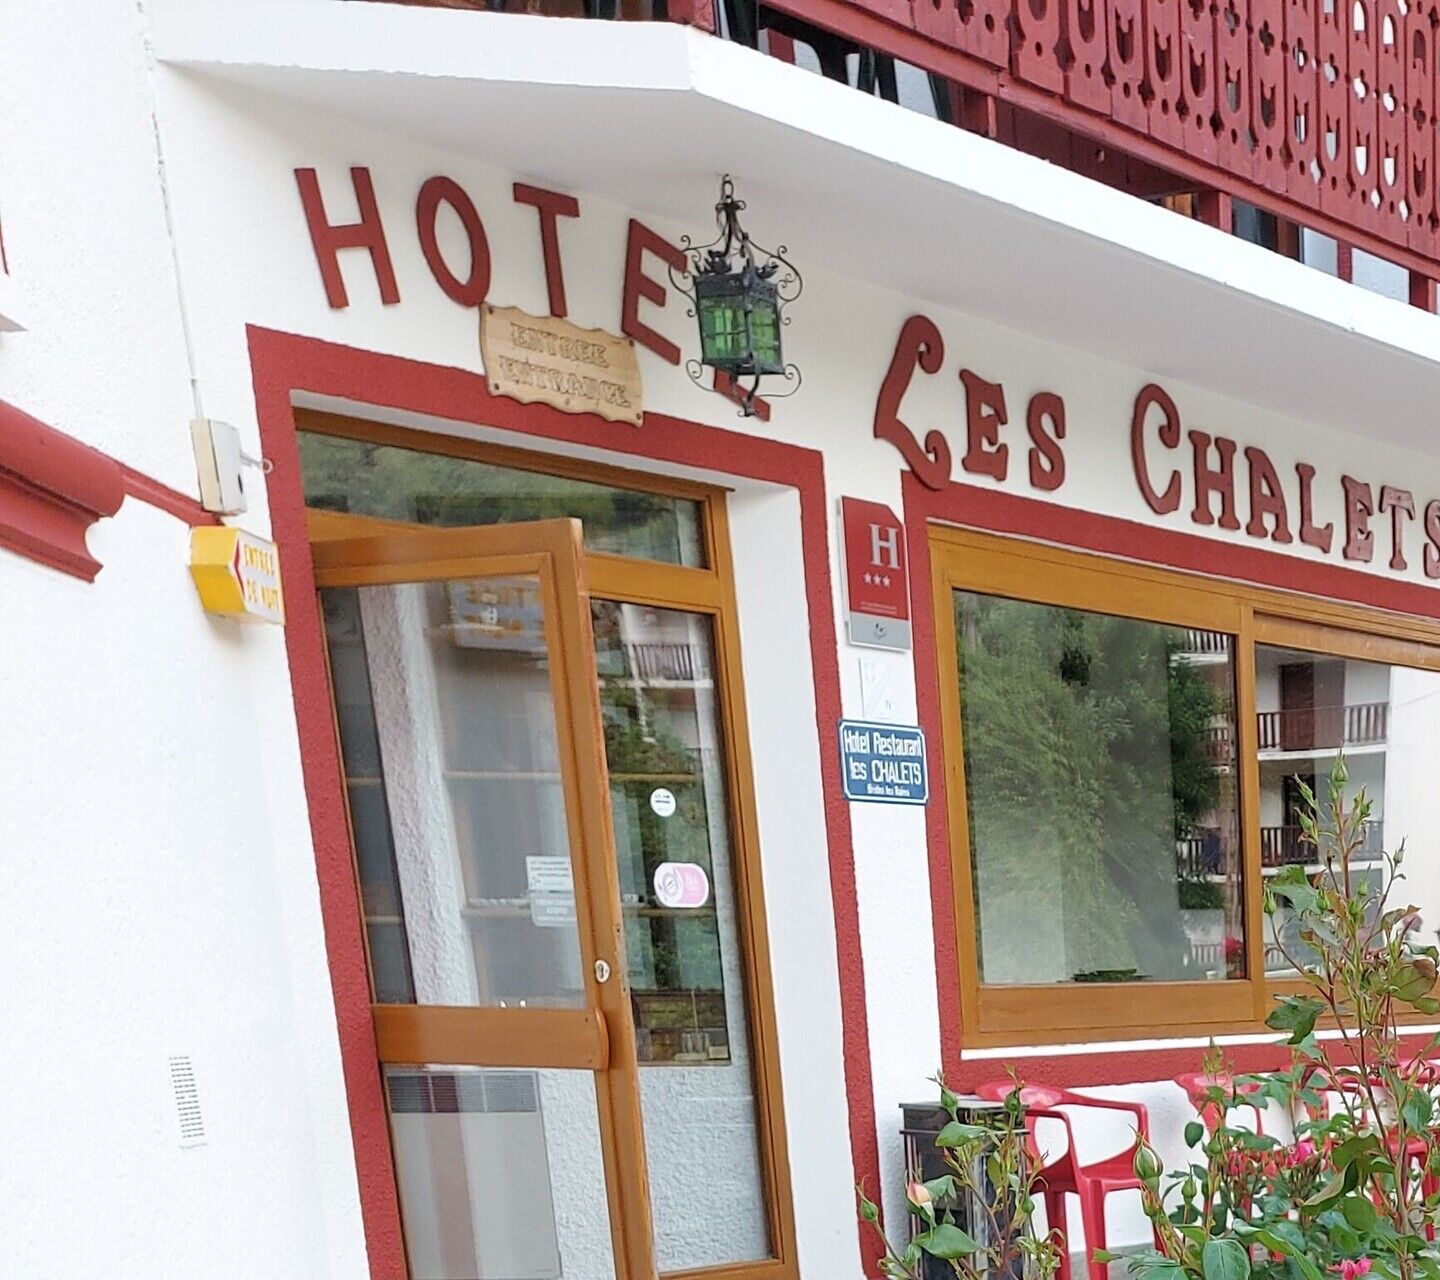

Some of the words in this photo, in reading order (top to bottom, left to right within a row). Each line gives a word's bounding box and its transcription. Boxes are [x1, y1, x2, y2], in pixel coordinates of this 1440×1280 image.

[867, 523, 900, 569] H
[844, 729, 870, 754] Hotel
[873, 732, 922, 757] Restaurant
[872, 760, 922, 785] CHALETS
